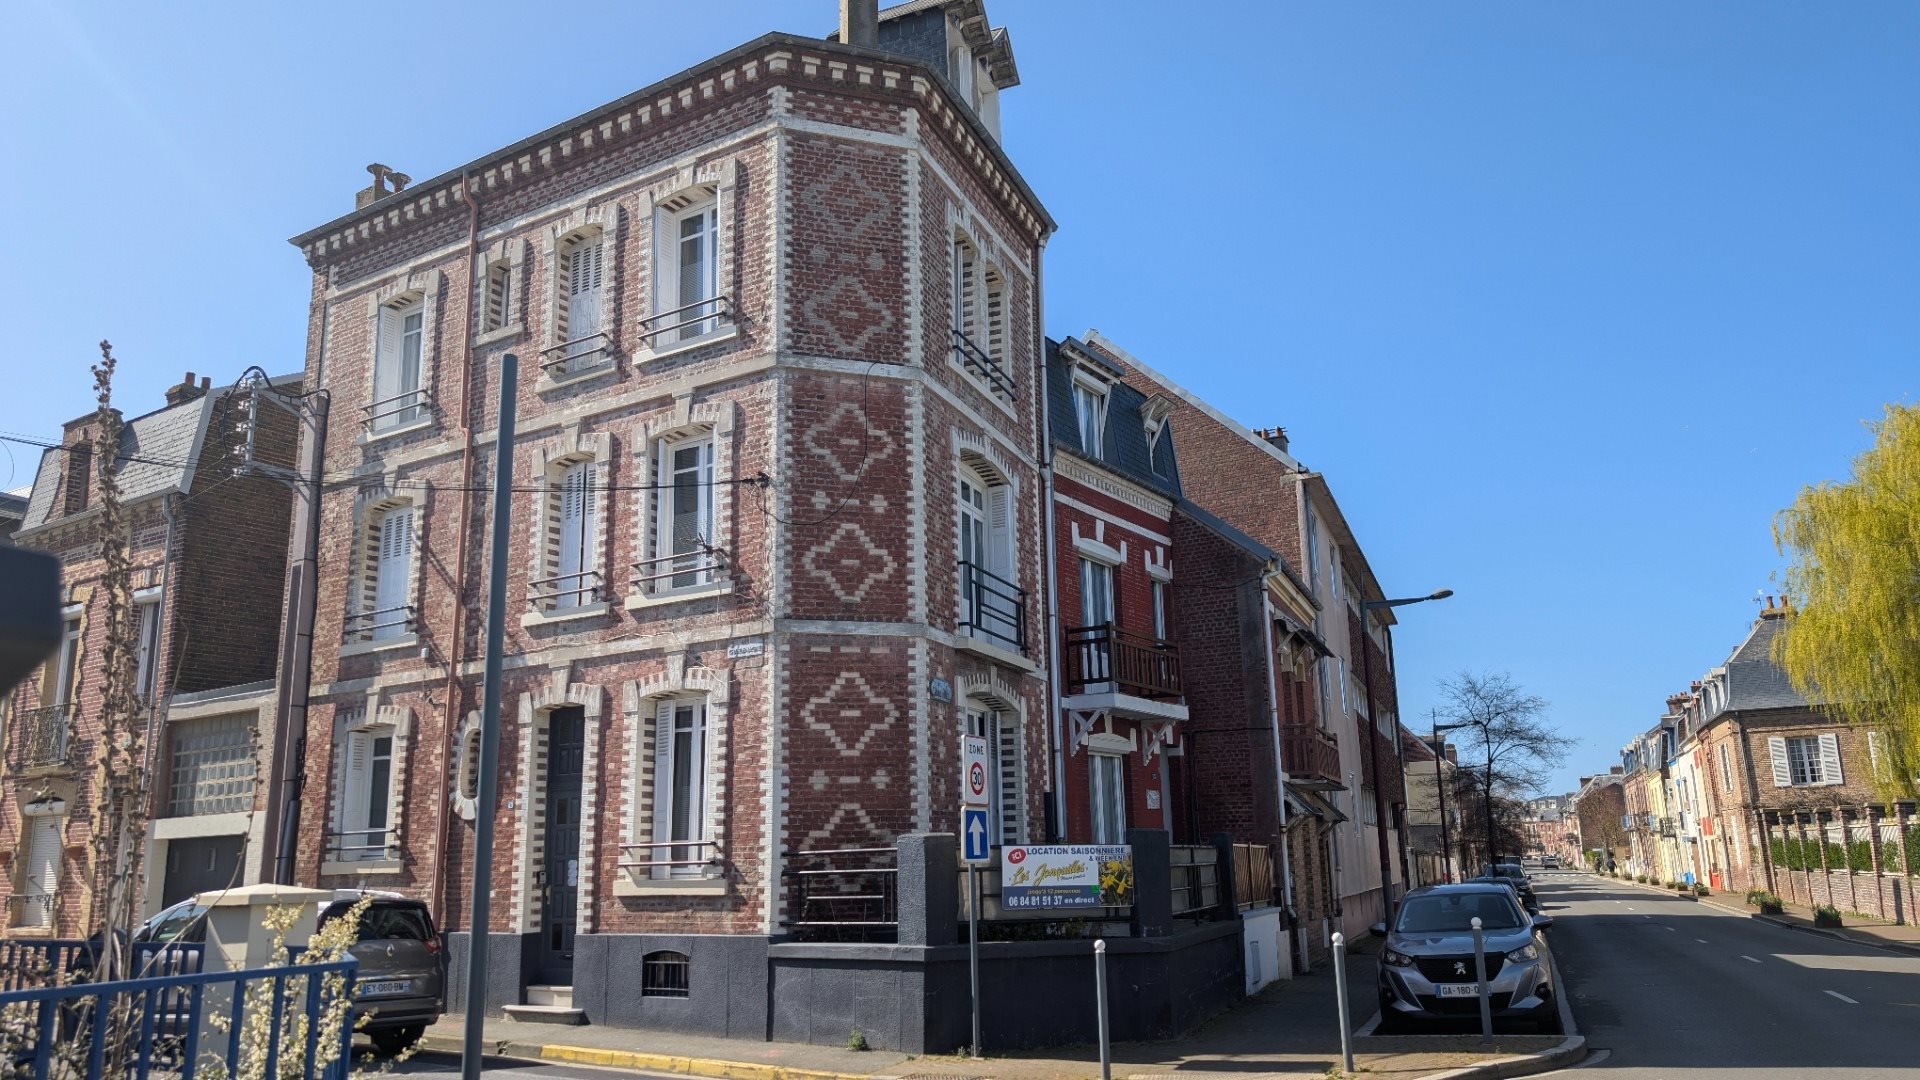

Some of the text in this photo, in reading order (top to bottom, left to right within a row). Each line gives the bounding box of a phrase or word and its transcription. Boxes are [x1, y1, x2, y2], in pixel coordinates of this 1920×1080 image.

[968, 744, 984, 755] ZONE
[972, 771, 981, 786] 30
[1011, 851, 1022, 861] ICI
[1027, 847, 1069, 855] LOCATION
[1008, 896, 1018, 907] 06
[1020, 896, 1030, 906] 84
[1031, 896, 1040, 906] 81
[1042, 896, 1051, 905] 51
[1053, 895, 1063, 905] 37
